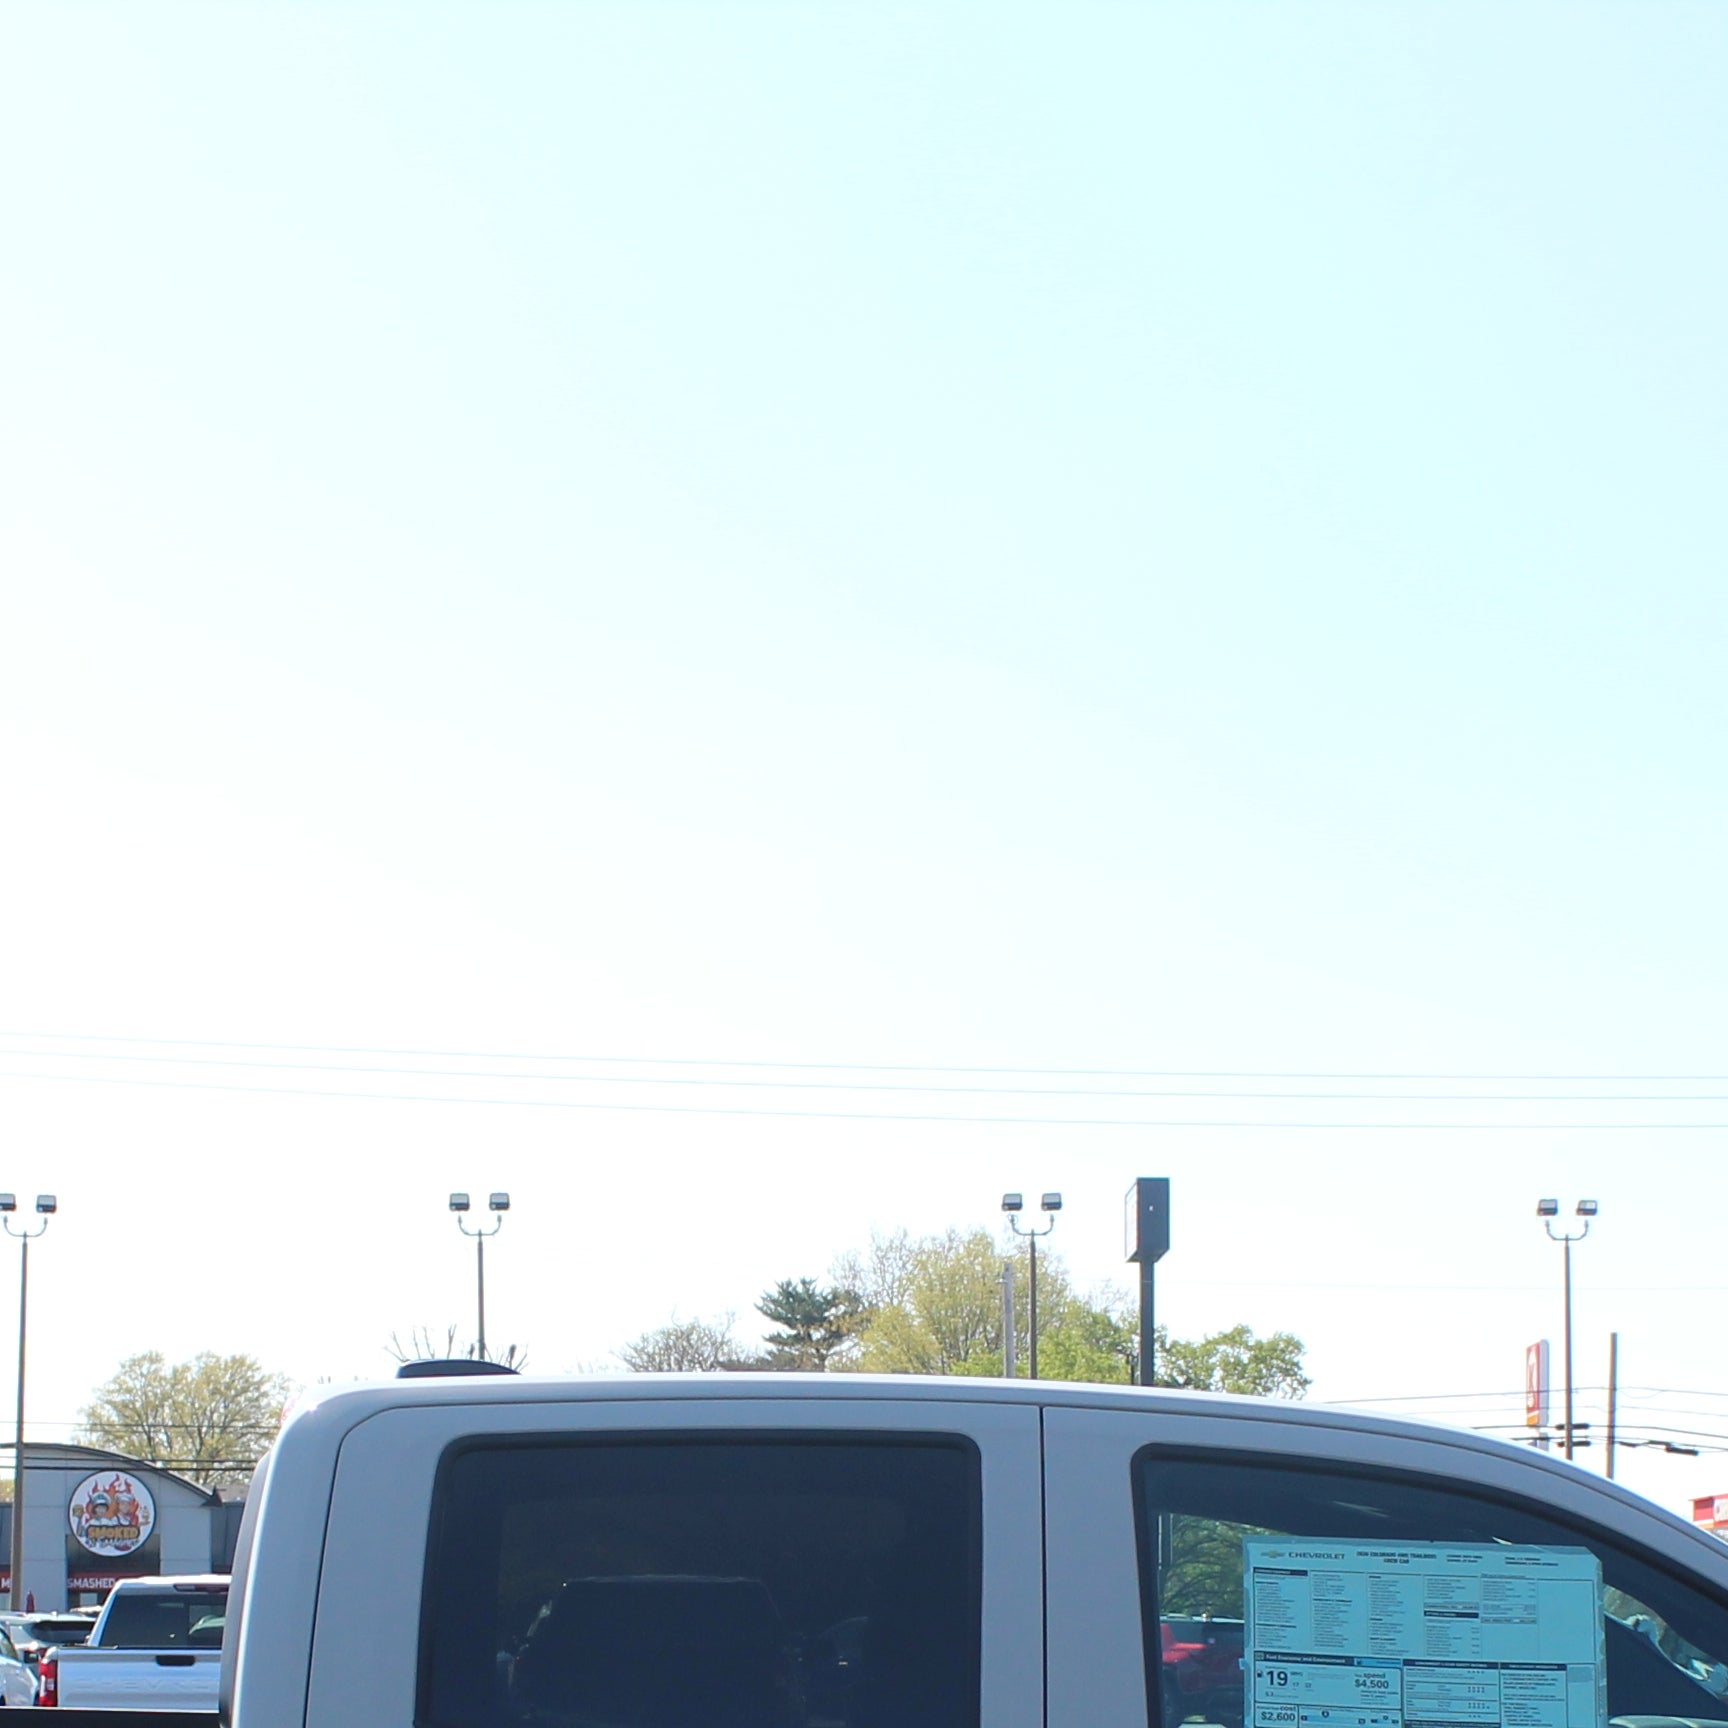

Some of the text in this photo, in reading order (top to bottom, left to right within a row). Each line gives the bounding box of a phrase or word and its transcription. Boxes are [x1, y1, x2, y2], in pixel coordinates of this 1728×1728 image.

[87, 1527, 138, 1539] SMOKED
[1288, 1551, 1346, 1560] CHEVROLET
[67, 1577, 115, 1588] SMASHED
[1266, 1670, 1288, 1687] 19
[1354, 1679, 1389, 1689] $4,500
[1261, 1711, 1296, 1721] $2,600
